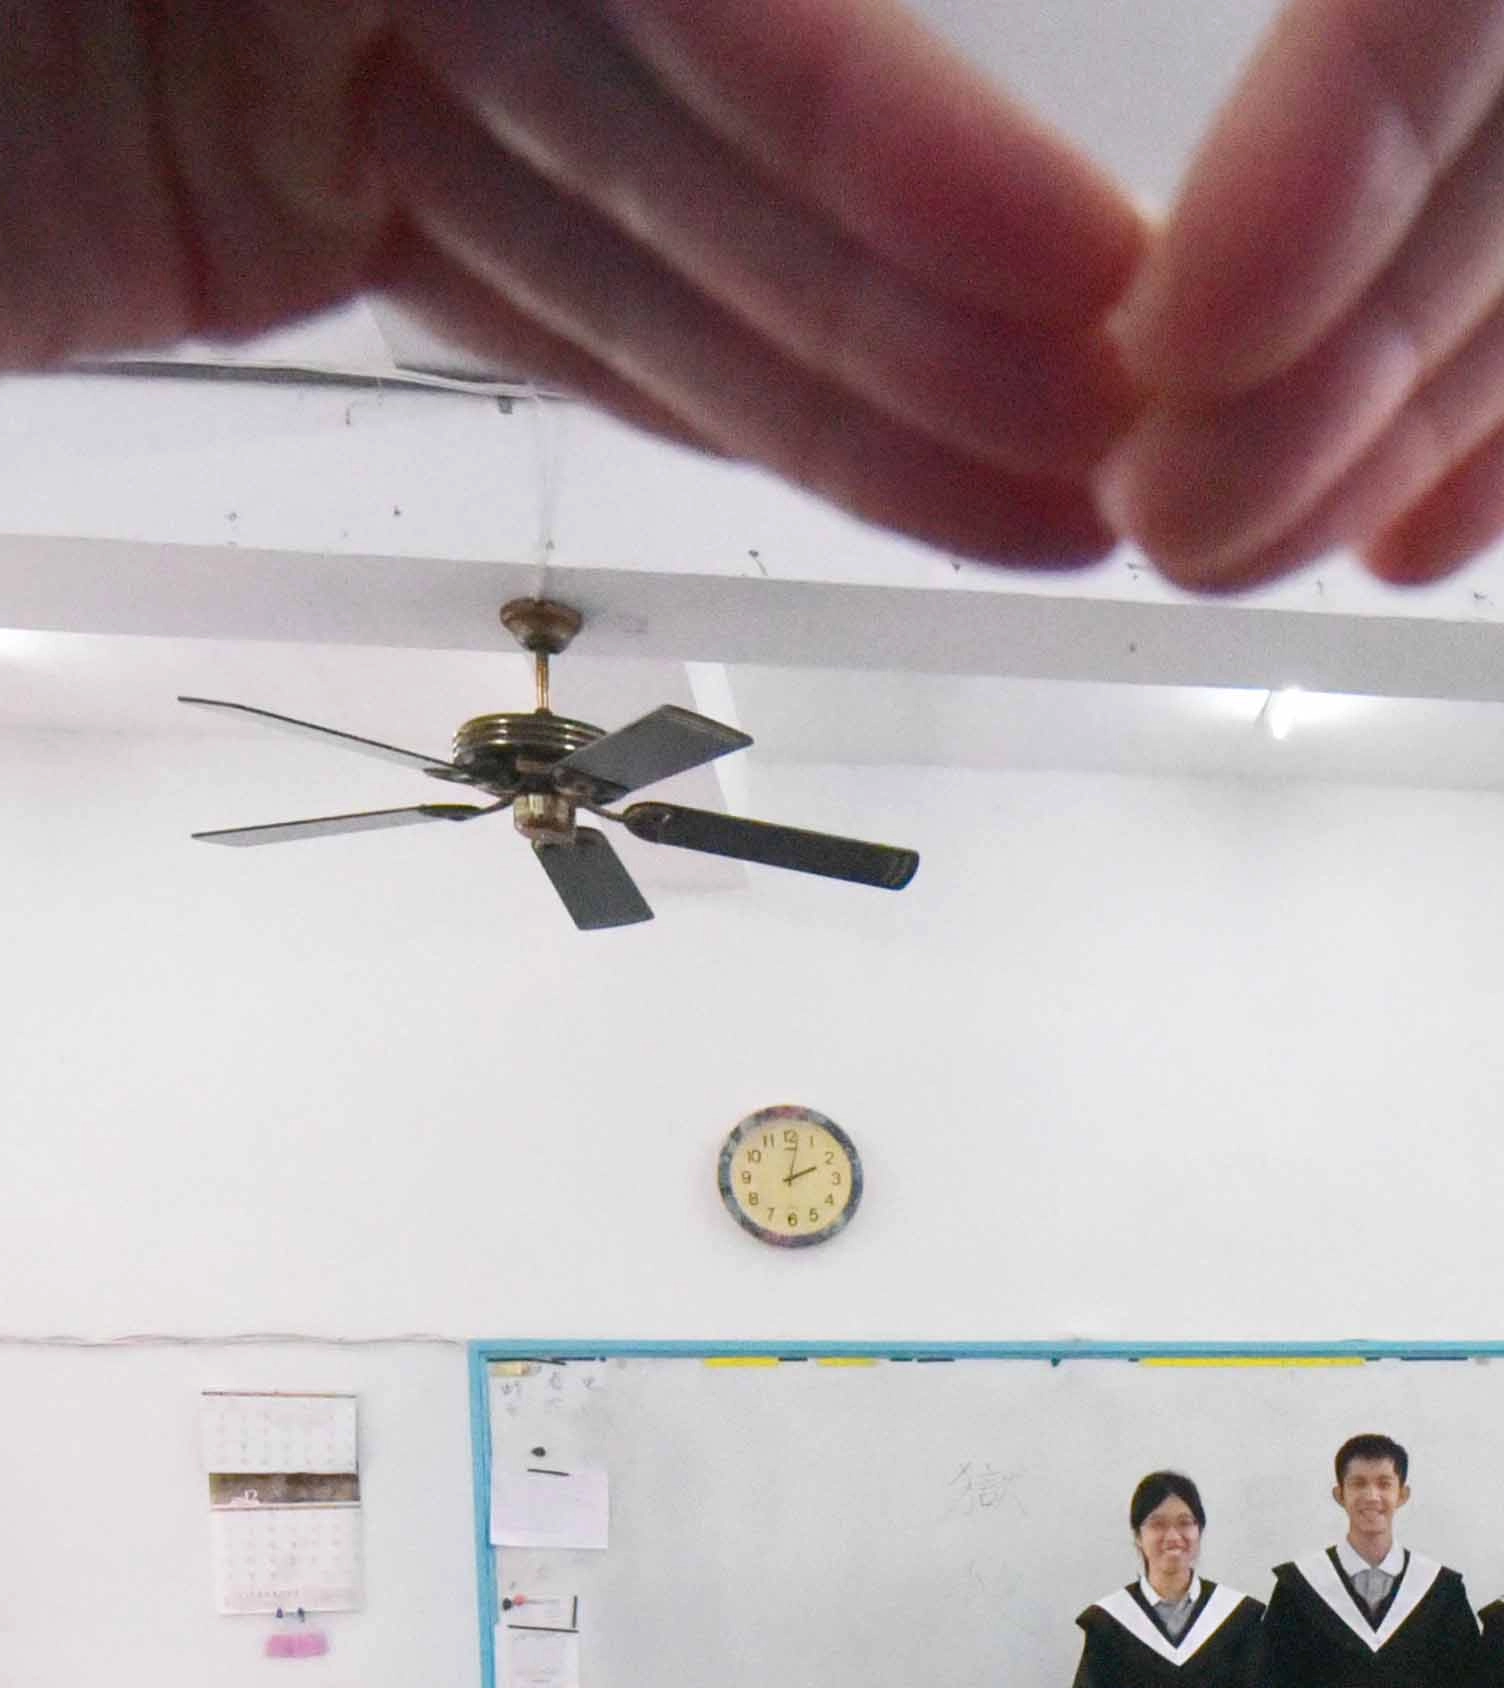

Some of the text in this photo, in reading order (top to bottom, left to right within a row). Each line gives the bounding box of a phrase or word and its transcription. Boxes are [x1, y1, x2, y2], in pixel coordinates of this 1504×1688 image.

[762, 1134, 775, 1148] 11
[747, 1149, 762, 1163] 10
[824, 1151, 835, 1164] 2
[742, 1171, 752, 1185] 9
[831, 1172, 841, 1186] 3
[824, 1193, 835, 1206] 4
[767, 1208, 776, 1221] 7
[787, 1211, 798, 1227] 6
[808, 1208, 819, 1222] 5
